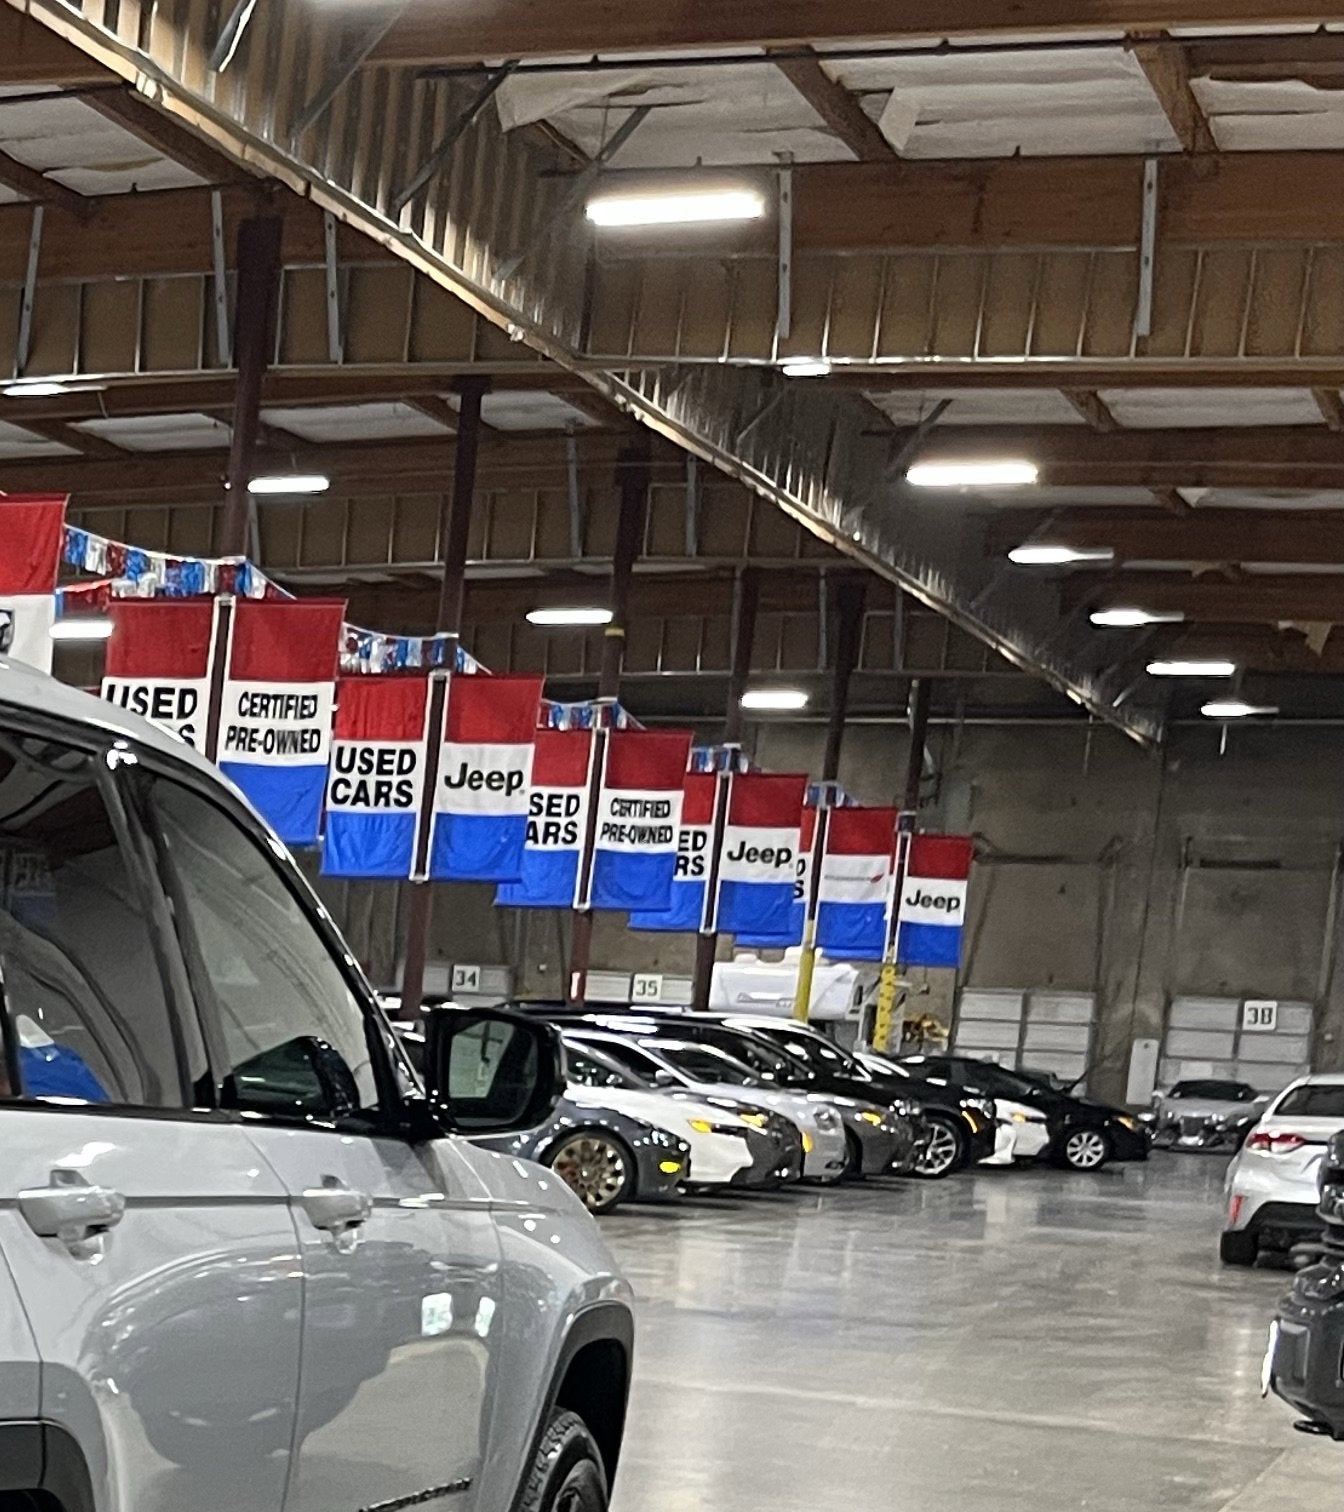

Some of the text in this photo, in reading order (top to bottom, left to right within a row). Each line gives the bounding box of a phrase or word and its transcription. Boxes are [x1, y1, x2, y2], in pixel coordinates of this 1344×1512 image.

[105, 683, 198, 720] USED
[237, 691, 319, 720] CERTIFIED
[224, 724, 322, 756] PRE-OWNED
[334, 745, 417, 776] USED
[330, 777, 414, 808] CARS
[443, 761, 524, 797] Jeep
[528, 791, 581, 818] SED
[609, 796, 672, 819] CERTIFIED
[525, 820, 578, 845] ARS
[599, 821, 674, 845] PRE-OWNED
[726, 840, 793, 868] Jeep
[904, 888, 961, 913] Jeep
[455, 969, 478, 987] 34
[635, 979, 658, 997] 35
